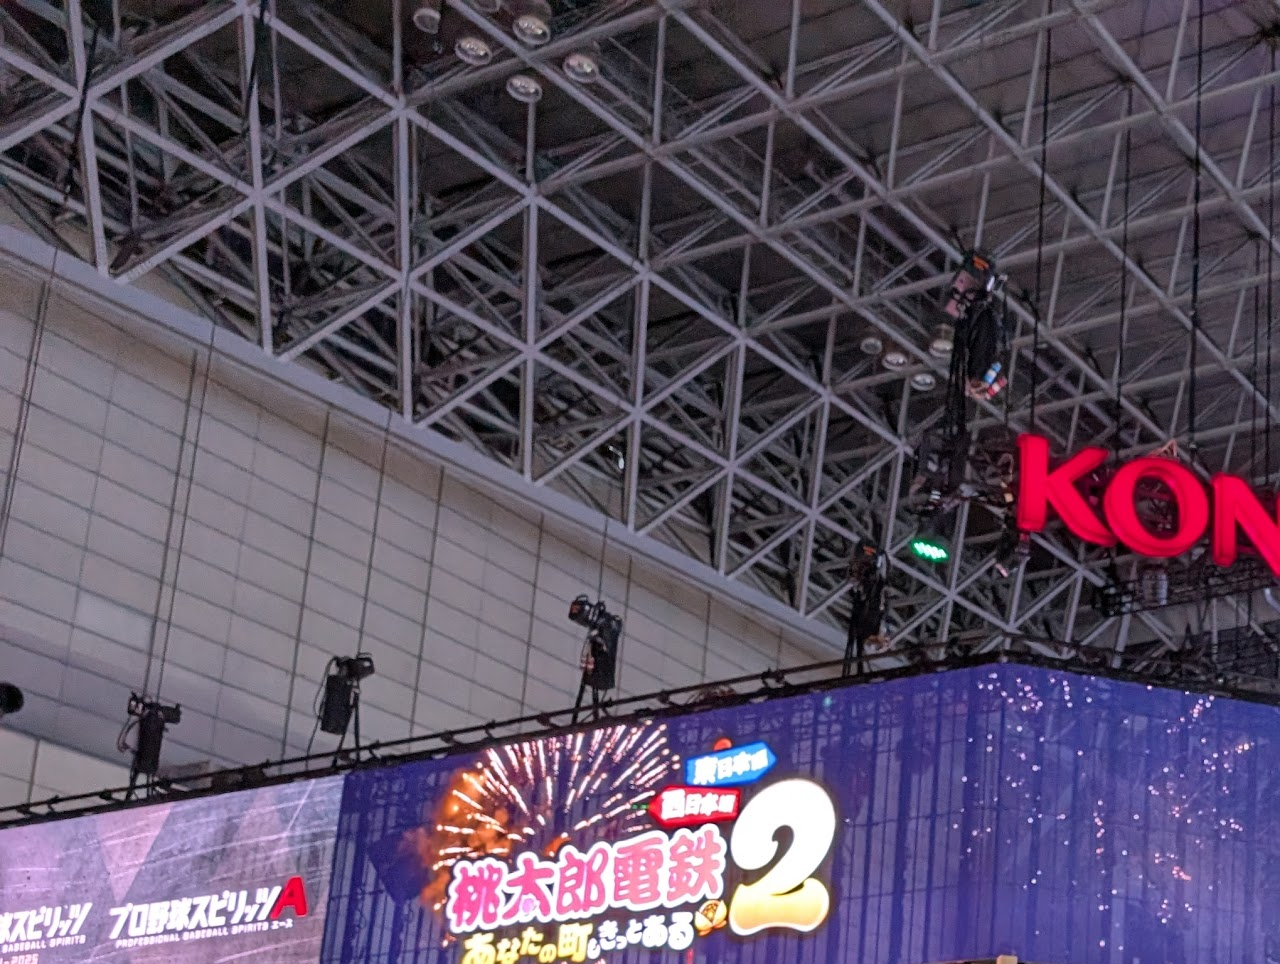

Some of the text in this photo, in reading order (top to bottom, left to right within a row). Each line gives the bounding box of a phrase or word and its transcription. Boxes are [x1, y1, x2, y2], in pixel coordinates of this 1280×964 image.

[448, 778, 837, 938] 桃太郎電鉄 2
